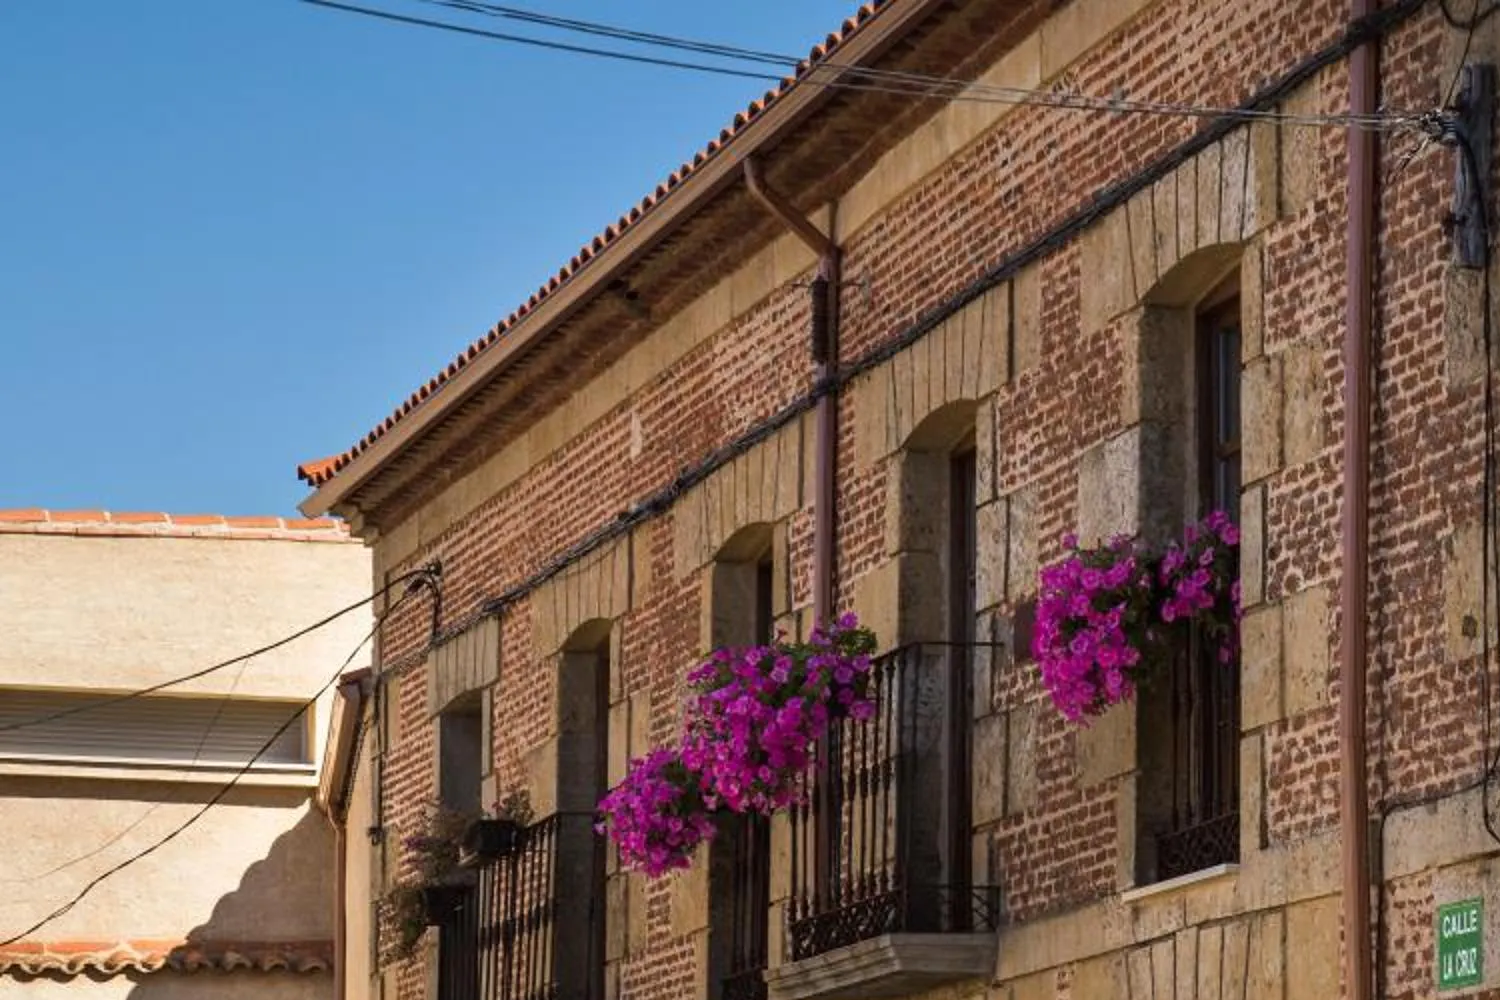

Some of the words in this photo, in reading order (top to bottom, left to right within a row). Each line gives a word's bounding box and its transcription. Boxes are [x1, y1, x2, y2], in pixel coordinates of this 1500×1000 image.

[1442, 908, 1478, 939] CALLE
[1443, 952, 1453, 980] LA
[1455, 947, 1477, 976] CRUZ
